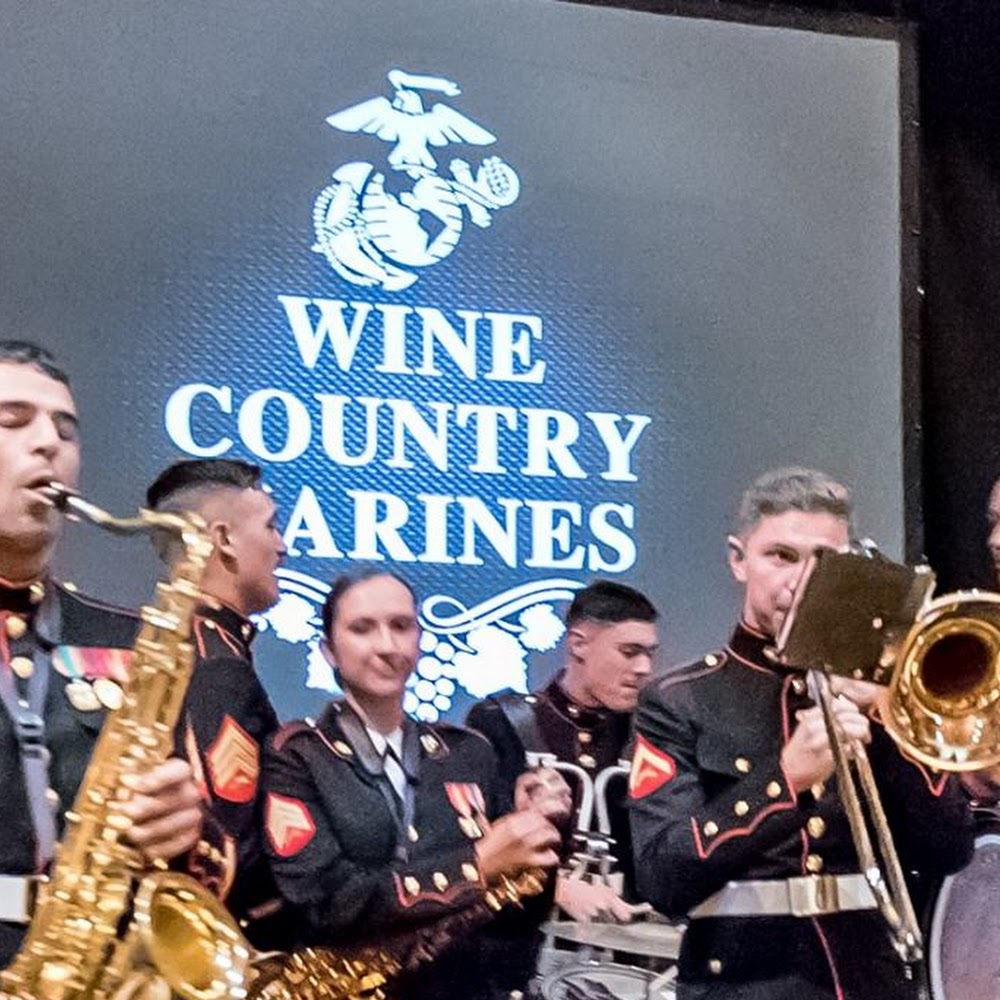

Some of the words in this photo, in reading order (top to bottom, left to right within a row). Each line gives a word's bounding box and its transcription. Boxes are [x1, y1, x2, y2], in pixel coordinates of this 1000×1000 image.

[278, 295, 545, 383] WINE
[164, 383, 651, 481] COUNTRY
[262, 484, 636, 572] ARINES
